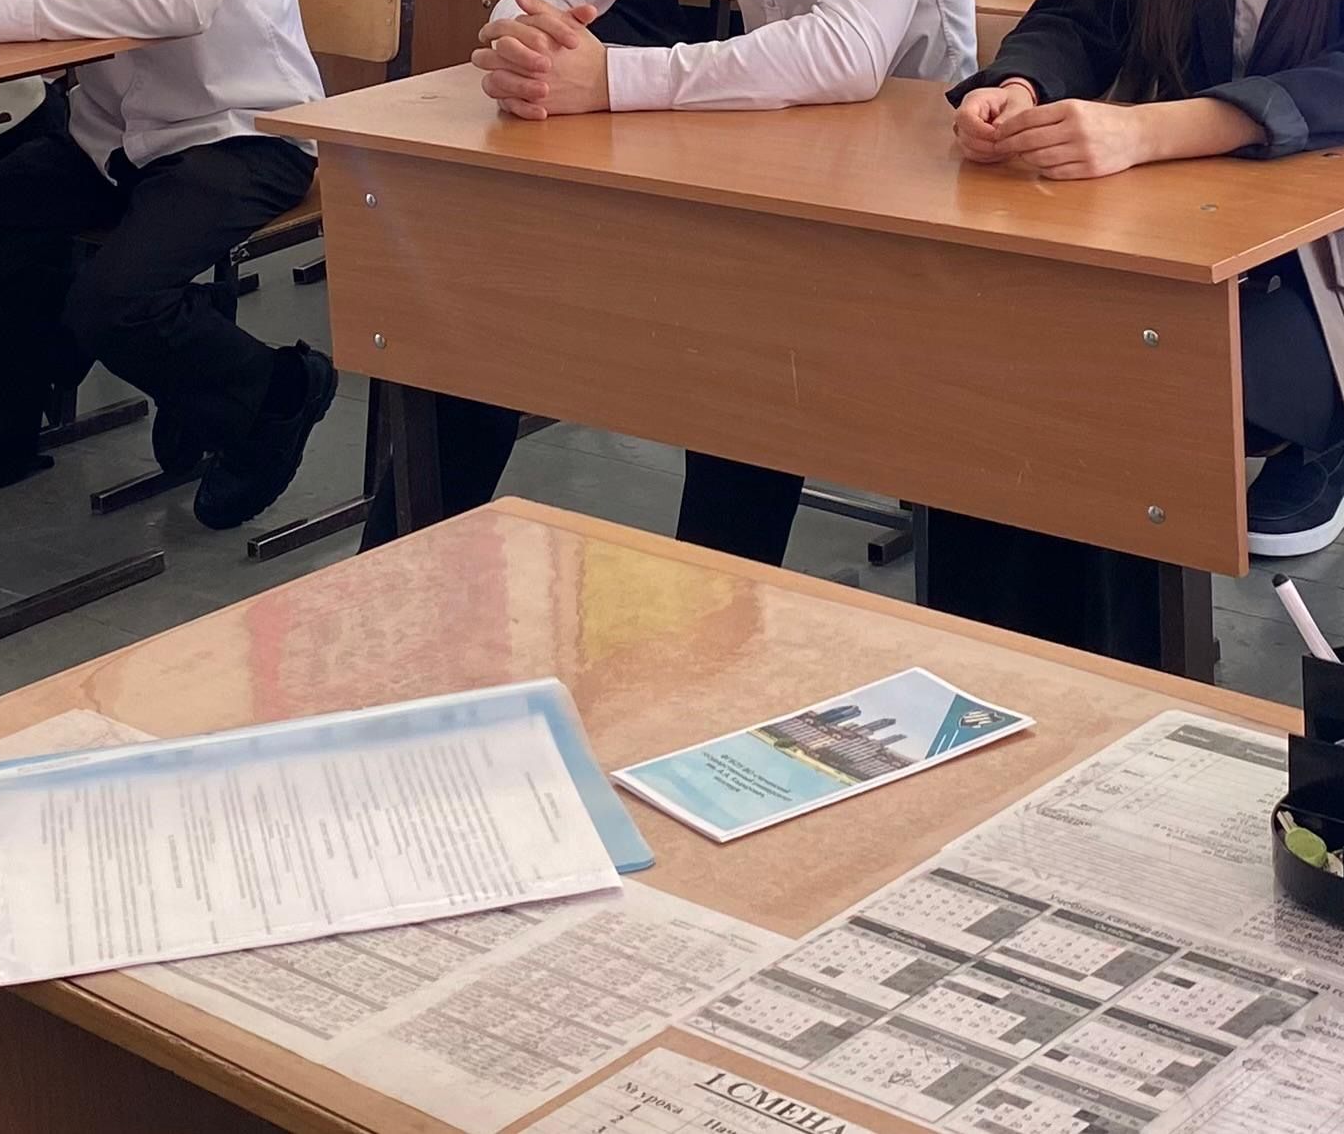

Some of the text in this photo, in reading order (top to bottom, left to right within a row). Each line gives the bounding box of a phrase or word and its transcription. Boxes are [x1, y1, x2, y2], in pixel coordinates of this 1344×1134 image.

[1049, 893, 1105, 918] Учебный
[1106, 914, 1176, 944] календарь
[1265, 963, 1330, 992] учебный
[640, 1091, 684, 1116] урока
[610, 1115, 625, 1124] 2
